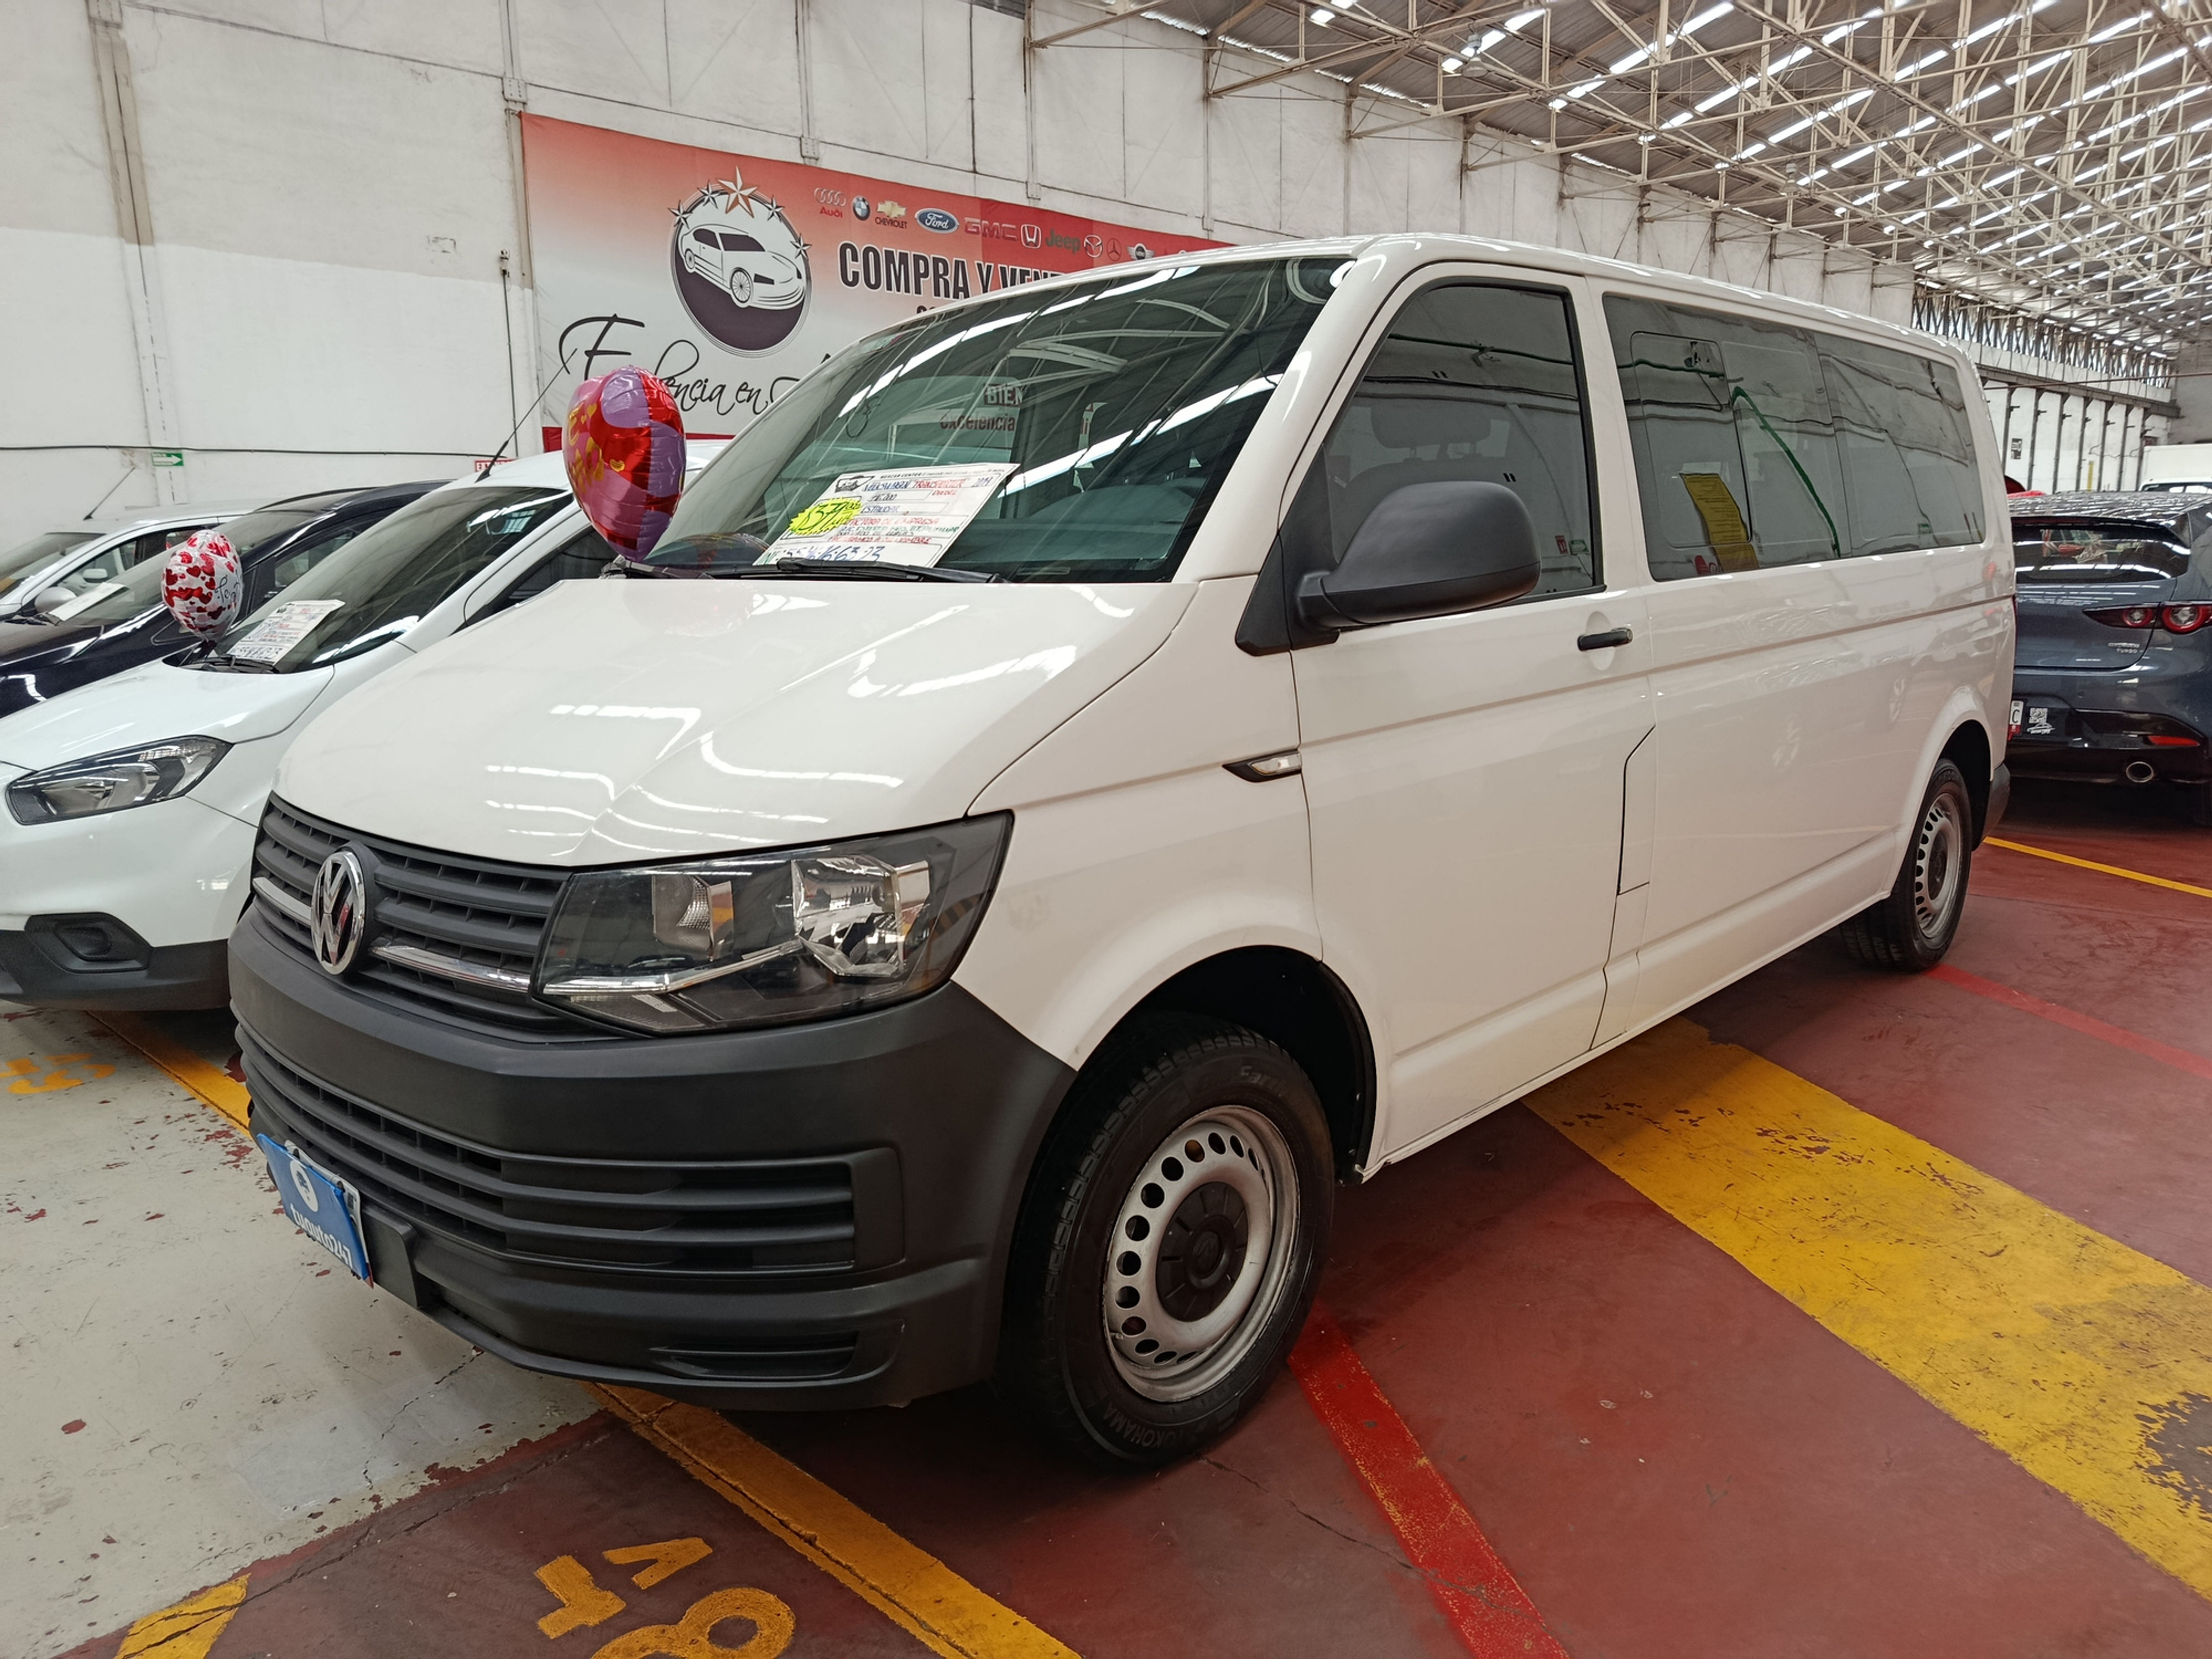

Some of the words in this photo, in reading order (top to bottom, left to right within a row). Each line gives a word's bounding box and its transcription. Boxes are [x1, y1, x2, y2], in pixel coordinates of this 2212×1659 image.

[874, 217, 907, 229] CHEVROLET
[925, 213, 950, 229] Ford
[964, 217, 1019, 242] GMC
[1045, 230, 1082, 254] Jeep
[838, 242, 971, 301] COMPRA
[975, 261, 995, 293] Y
